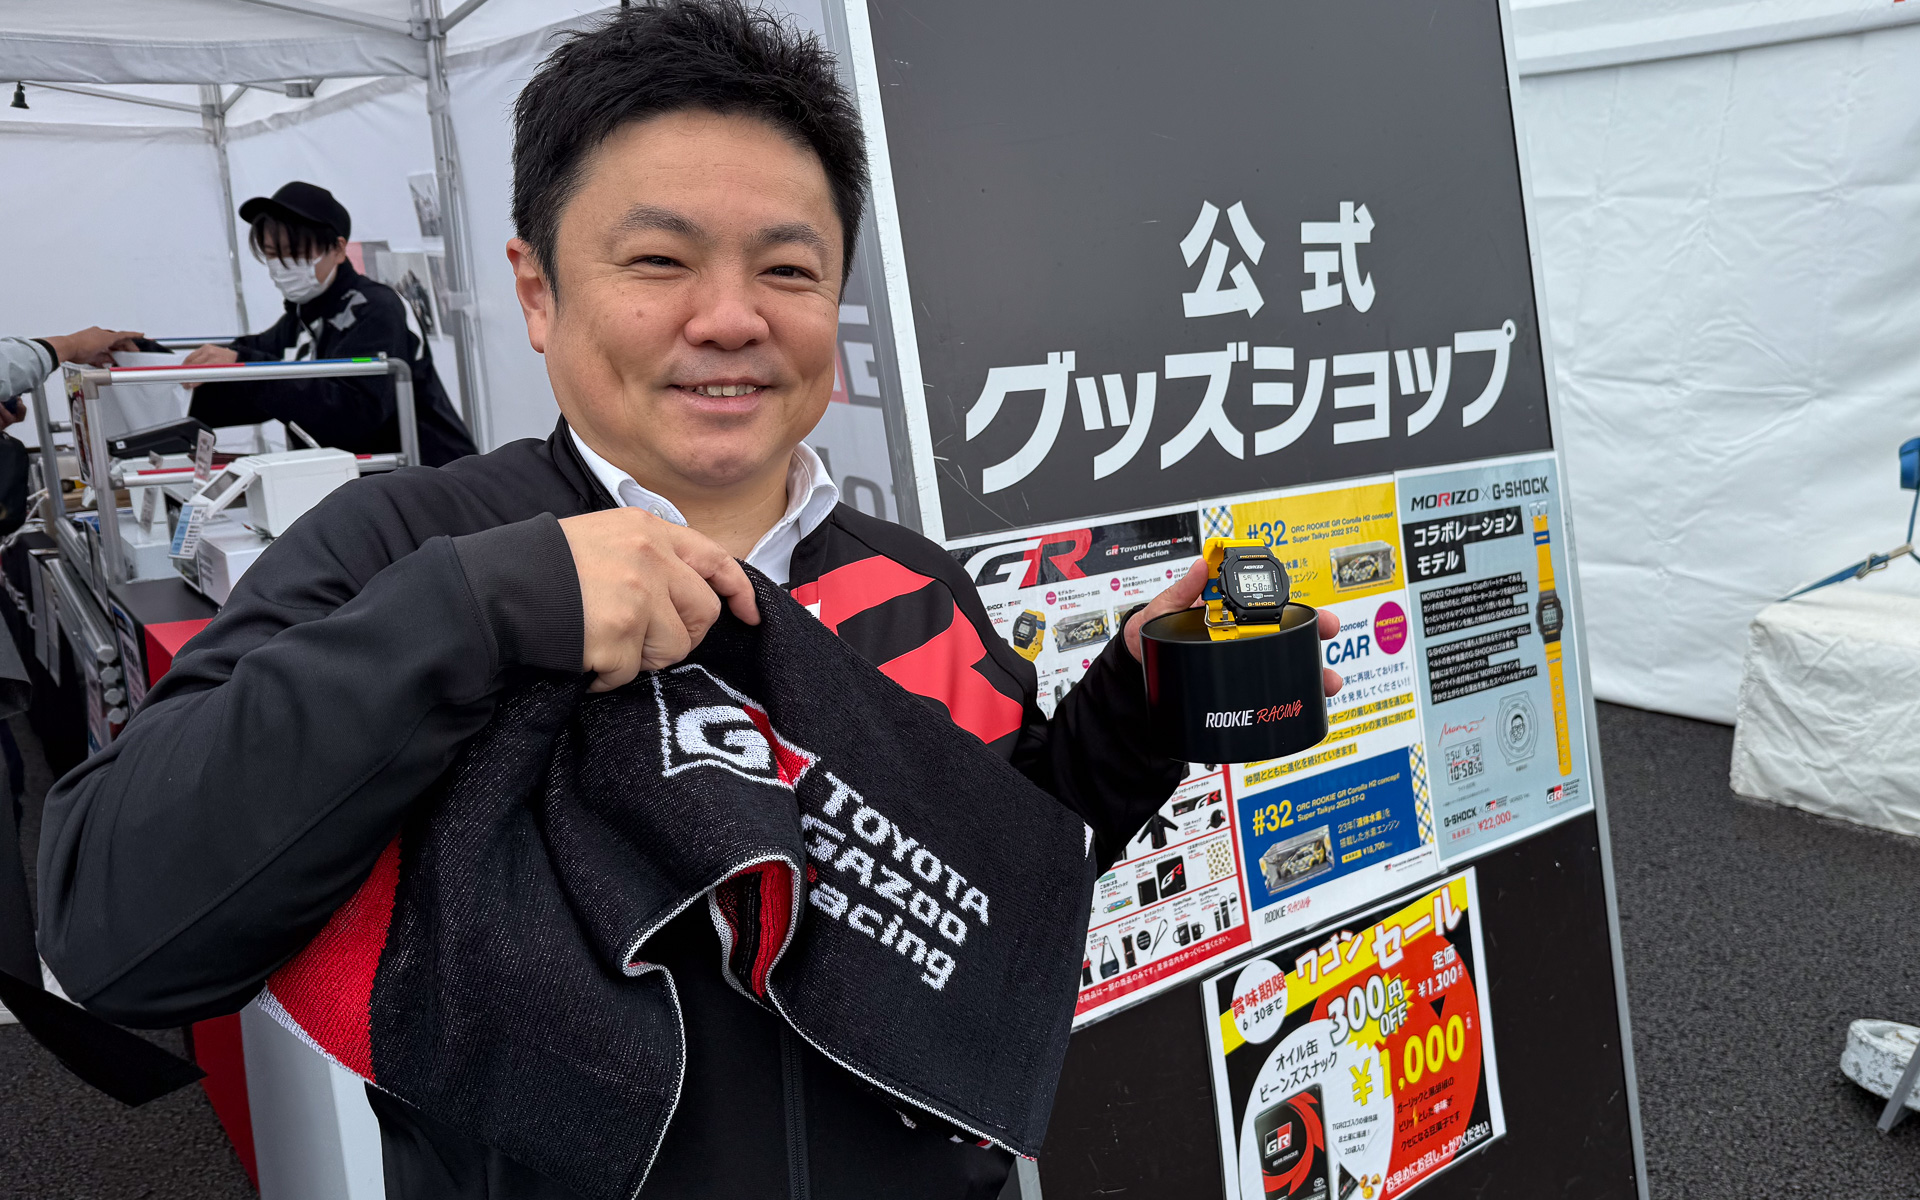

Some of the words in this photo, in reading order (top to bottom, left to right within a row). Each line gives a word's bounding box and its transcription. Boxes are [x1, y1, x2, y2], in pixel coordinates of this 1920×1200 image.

[1179, 199, 1377, 319] 公式
[965, 318, 1517, 494] グッズショップ
[1411, 488, 1479, 512] MORIZO
[1492, 476, 1549, 500] G-SHOCK
[1105, 544, 1119, 556] GR
[1119, 543, 1147, 553] TOYOTA
[1147, 538, 1171, 549] GAZOO
[1171, 534, 1193, 545] Racing
[1247, 519, 1288, 548] #32
[1291, 525, 1305, 534] ORC
[1306, 521, 1331, 532] ROOKIE
[1331, 519, 1341, 528] GR
[1342, 516, 1362, 526] Corolla
[1362, 514, 1371, 522] H2
[1371, 511, 1394, 522] concept
[1292, 534, 1310, 544] Super
[1311, 529, 1330, 541] Taikyu
[1330, 528, 1345, 538] 2022
[1345, 527, 1359, 536] ST-Q
[1413, 513, 1518, 548] コラボレーション
[963, 528, 1093, 590] GR
[1133, 549, 1169, 561] collection
[1417, 550, 1459, 576] モデル
[986, 603, 1004, 611] -SHOCK
[1376, 614, 1404, 628] MORIZO
[1340, 618, 1368, 632] concept
[1326, 634, 1370, 665] CAR
[1342, 661, 1409, 687] 実に再現しております。
[1205, 709, 1255, 728] ROOKIE
[1256, 699, 1304, 724] RACING
[675, 705, 771, 770] G
[1252, 799, 1294, 836] #32
[1296, 801, 1310, 812] ORC
[1311, 792, 1336, 807] ROOKIE
[1337, 789, 1347, 799] GR
[1347, 783, 1368, 796] Corolla
[1368, 780, 1377, 790] H2
[1377, 773, 1400, 787] concept
[1297, 810, 1315, 822] Super
[1316, 803, 1336, 818] Taikyu
[1336, 799, 1350, 810] 2023
[1351, 793, 1365, 805] ST-Q
[1444, 806, 1477, 828] G-SHOCK
[1478, 811, 1512, 831] ¥22,000
[823, 771, 990, 927] TOYOTA
[800, 813, 968, 947] GAZOO
[1160, 863, 1184, 890] GR
[806, 863, 957, 990] acing
[1264, 905, 1287, 925] ROOKIE
[1296, 884, 1462, 985] ワゴンセール
[1431, 944, 1456, 971] 定価
[1231, 971, 1287, 1019] 賞味期限
[1327, 974, 1405, 1047] 300円
[1242, 998, 1283, 1032] 6/30まで
[1379, 1005, 1408, 1038] OFF
[1275, 1038, 1319, 1073] オイル缶
[1349, 1014, 1465, 1107] ¥1,000
[1259, 1051, 1338, 1103] ビーンズスナック
[1266, 1132, 1291, 1155] GR
[1385, 1120, 1491, 1193] お早めにお召し上がりください
